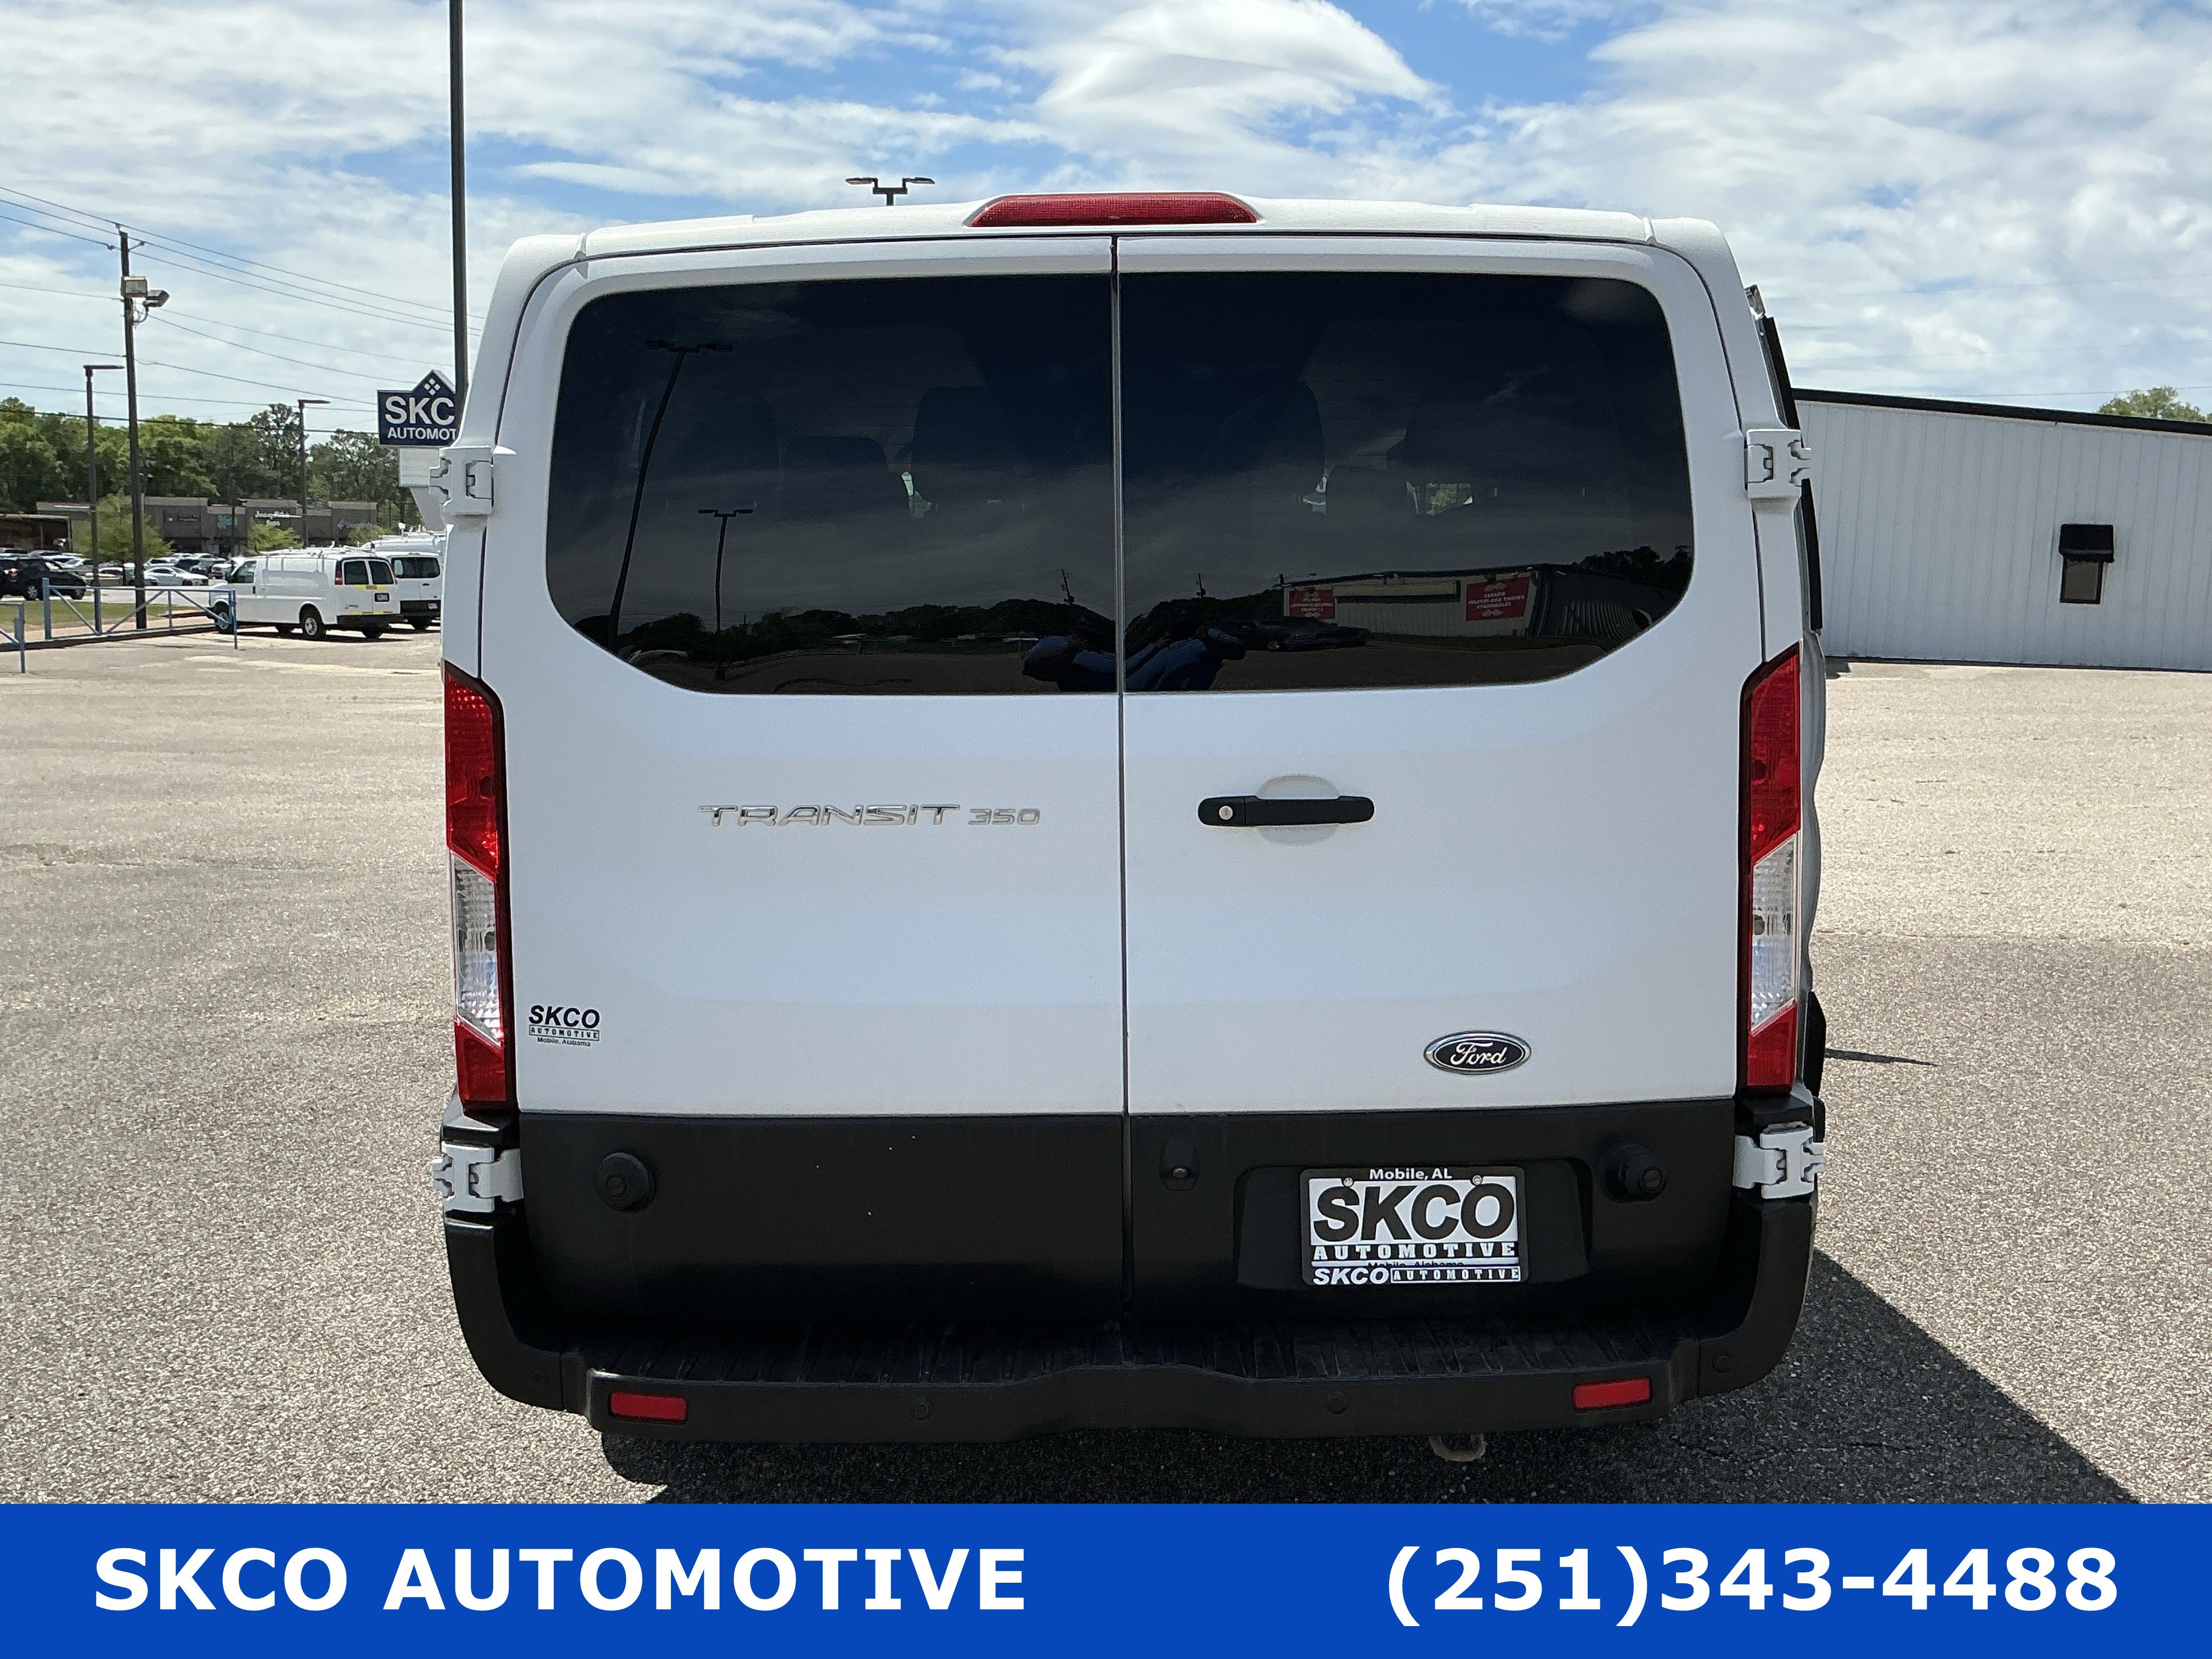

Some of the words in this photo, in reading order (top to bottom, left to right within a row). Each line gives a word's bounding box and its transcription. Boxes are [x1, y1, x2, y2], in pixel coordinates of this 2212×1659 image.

[387, 427, 457, 441] AUTOMOT
[698, 805, 961, 827] TRANSIT
[967, 808, 1041, 826] 350
[528, 1005, 600, 1029] SKCO
[530, 1026, 599, 1039] AUTOMOTIVE
[1450, 1042, 1508, 1065] Ford
[1369, 1168, 1429, 1181] Mobile,
[1431, 1168, 1453, 1180] AL
[1313, 1183, 1515, 1243] SKCO
[1313, 1243, 1515, 1261] AUTOMOTIVE
[1313, 1267, 1390, 1285] SKCO
[1393, 1268, 1519, 1280] AUTOMOTIVE
